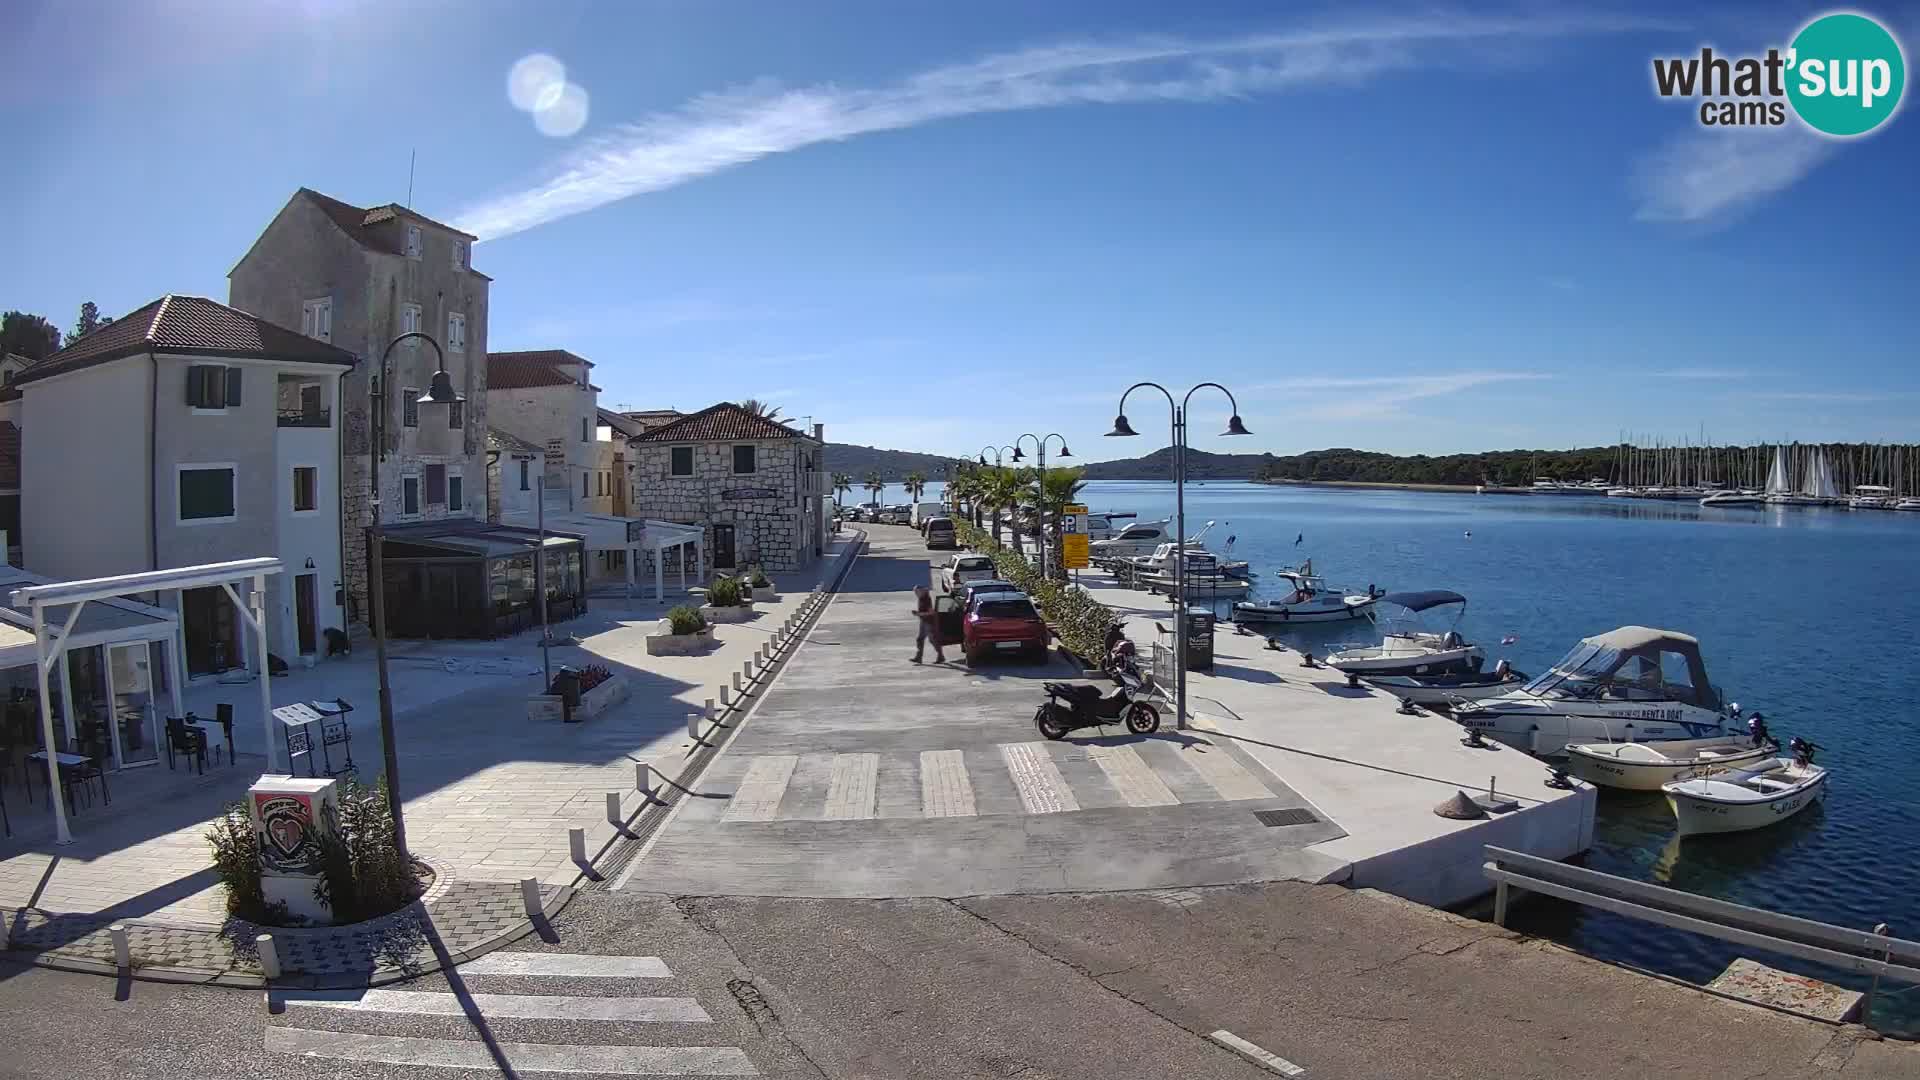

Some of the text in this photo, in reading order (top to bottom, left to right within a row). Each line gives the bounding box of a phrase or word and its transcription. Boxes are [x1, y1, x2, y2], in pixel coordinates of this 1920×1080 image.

[1065, 515, 1076, 532] P
[1641, 709, 1659, 719] RENT
[1660, 709, 1665, 719] A
[1666, 710, 1683, 721] BOAT
